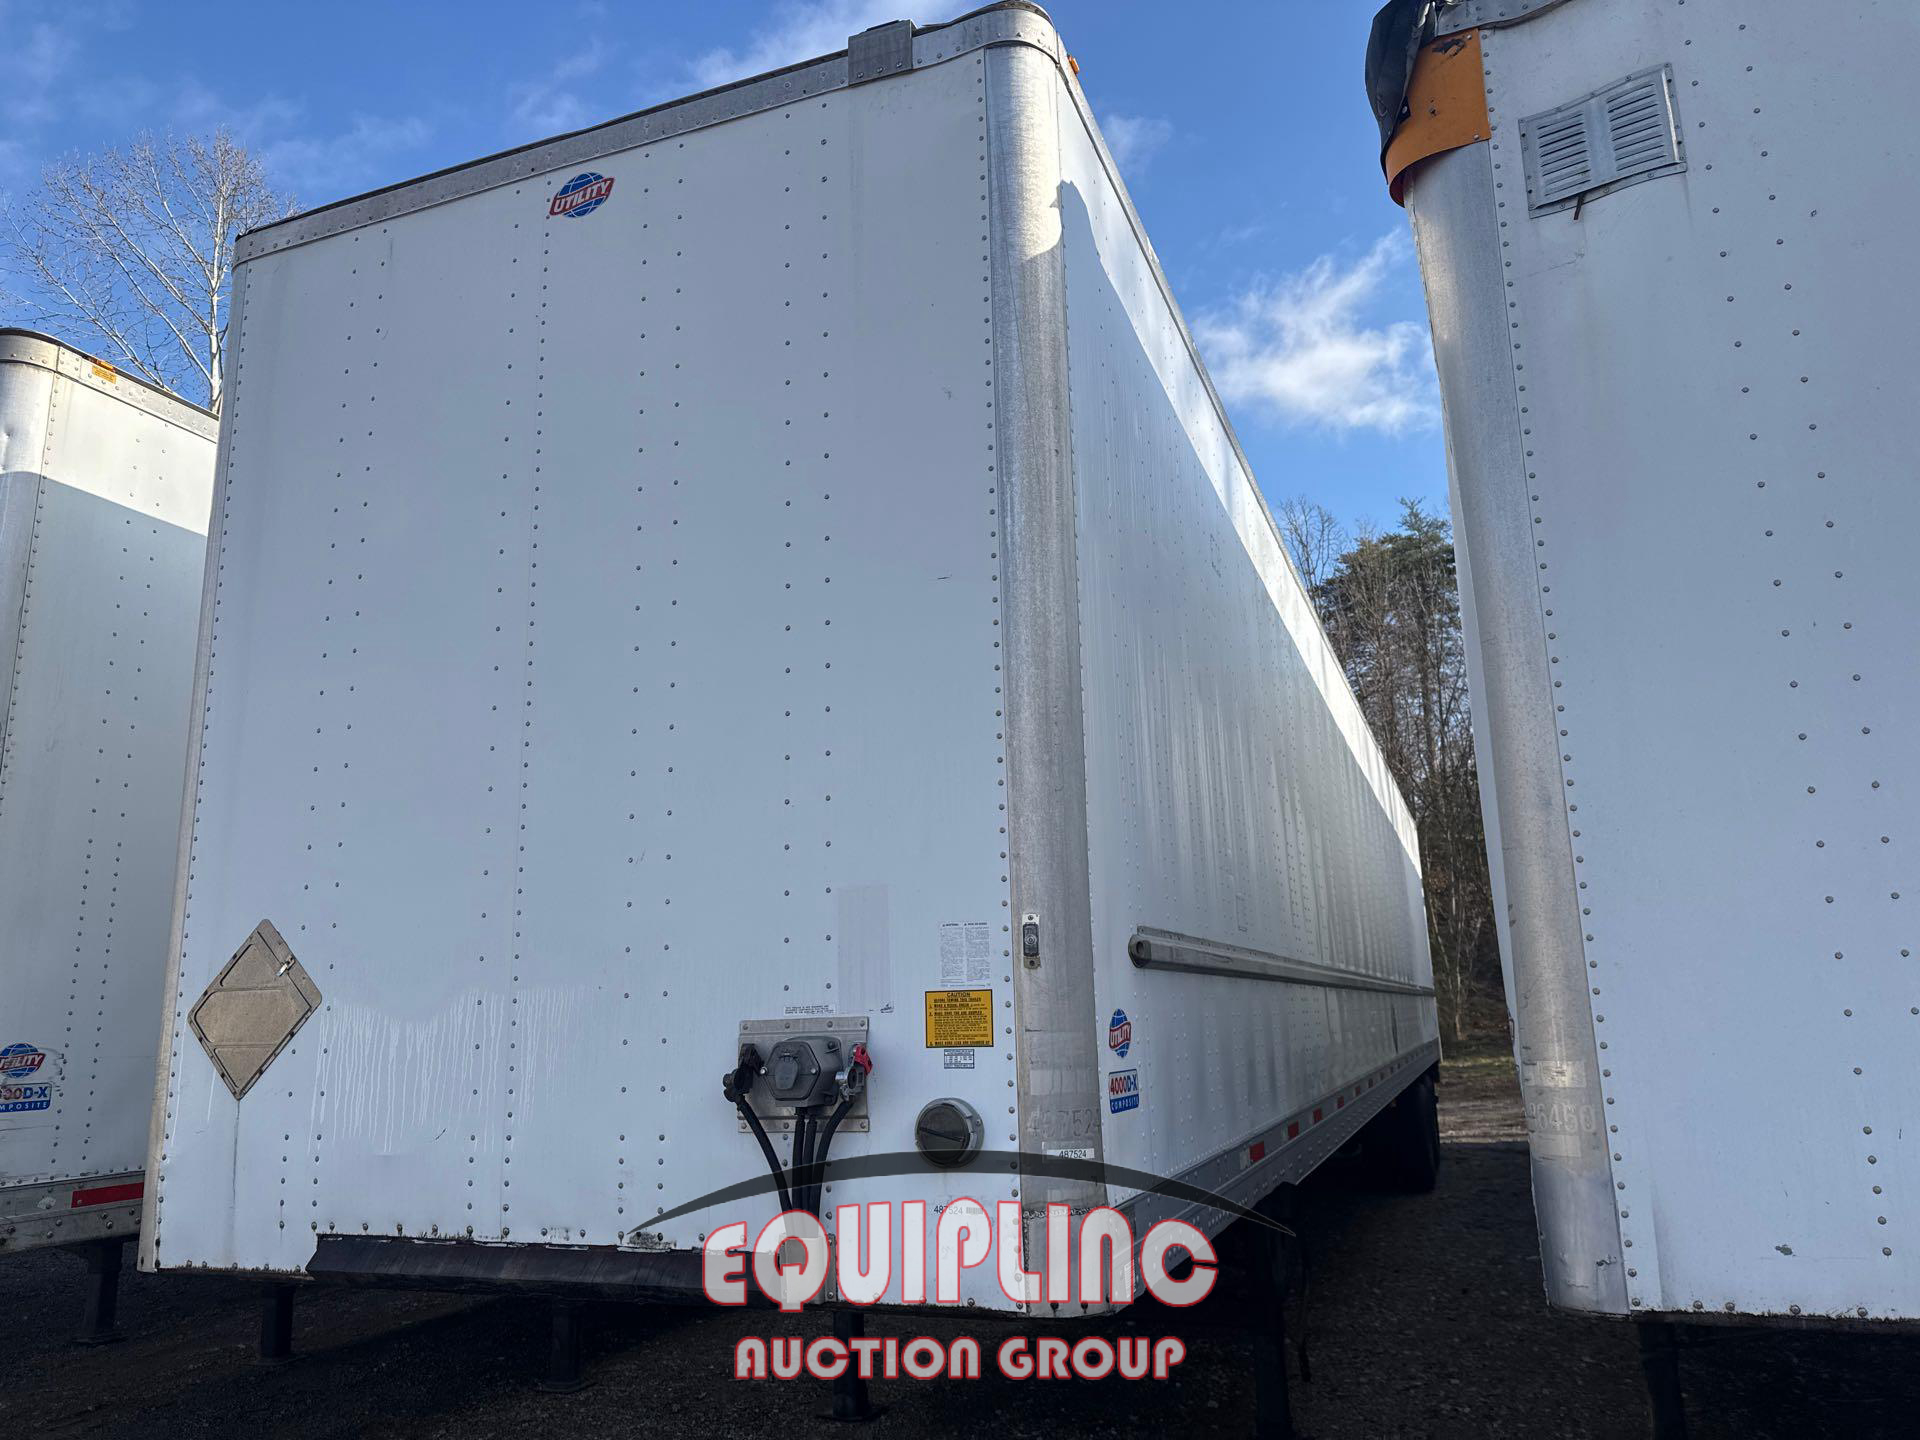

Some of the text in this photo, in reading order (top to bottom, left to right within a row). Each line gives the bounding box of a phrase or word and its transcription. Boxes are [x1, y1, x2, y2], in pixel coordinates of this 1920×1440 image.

[553, 180, 612, 213] UTILITY
[1110, 1024, 1131, 1046] UTILITY
[1110, 1074, 1138, 1096] 4000D-X
[1059, 1150, 1087, 1159] 487524
[933, 1205, 963, 1215] 487524
